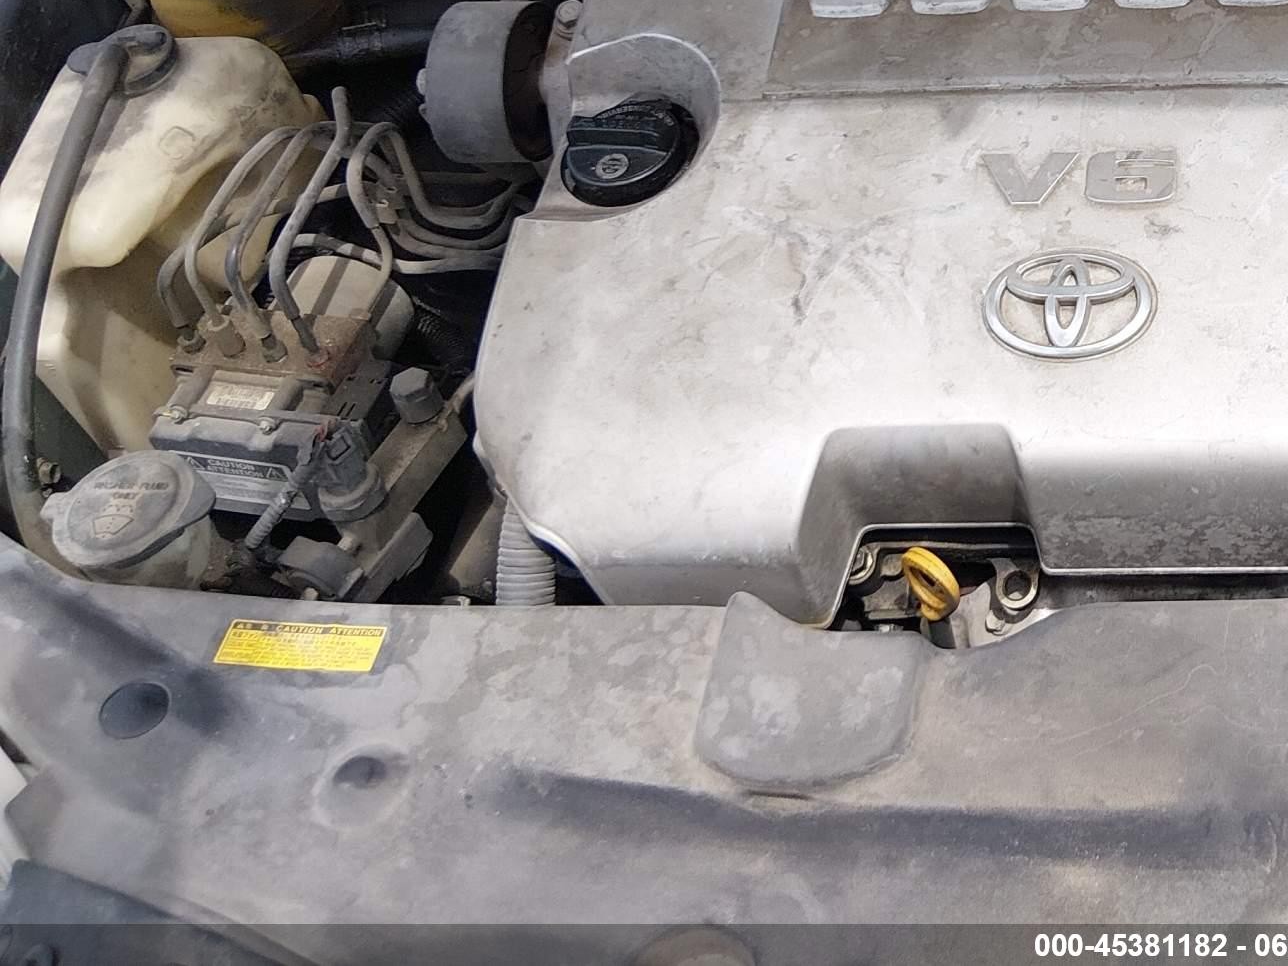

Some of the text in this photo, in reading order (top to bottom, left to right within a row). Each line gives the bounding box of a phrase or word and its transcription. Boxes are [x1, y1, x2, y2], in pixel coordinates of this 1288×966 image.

[980, 150, 1177, 205] V6
[207, 459, 255, 470] CAUTION
[276, 625, 323, 634] CAUTION
[330, 626, 382, 636] ATTENTION
